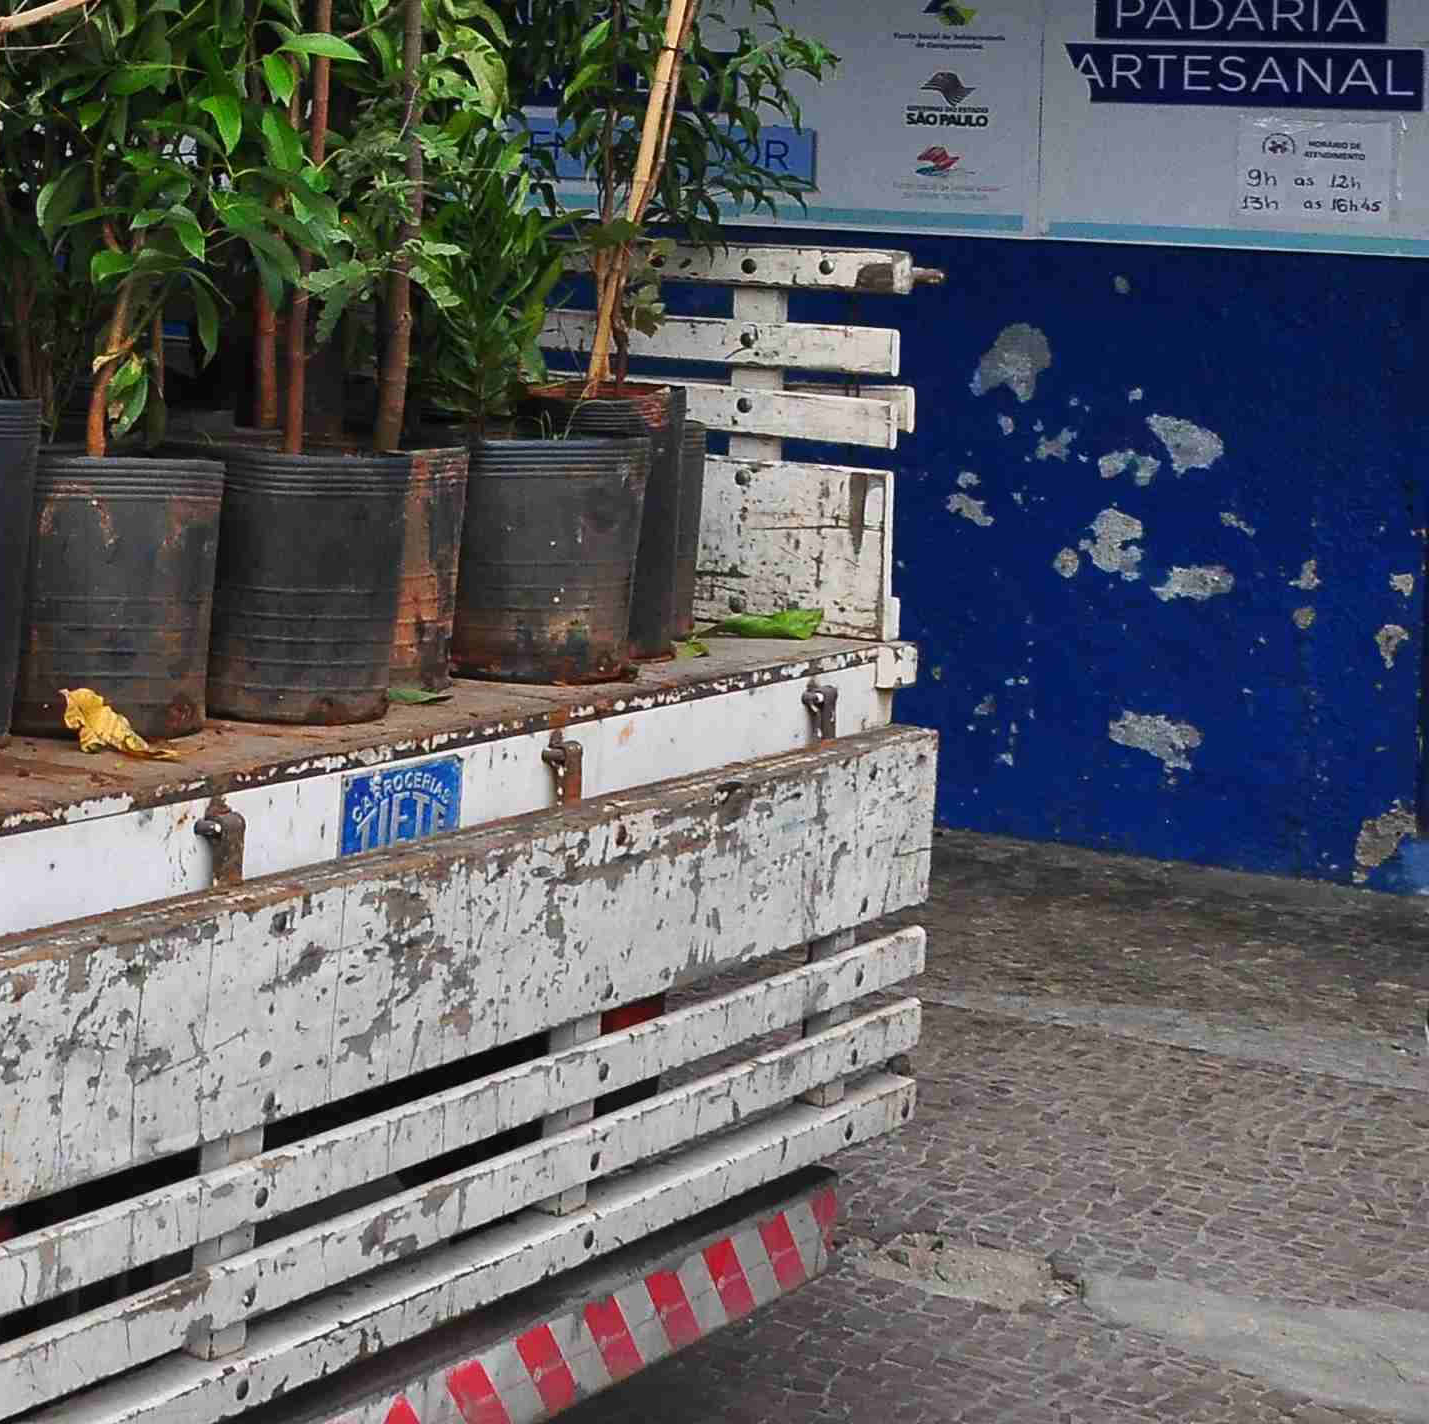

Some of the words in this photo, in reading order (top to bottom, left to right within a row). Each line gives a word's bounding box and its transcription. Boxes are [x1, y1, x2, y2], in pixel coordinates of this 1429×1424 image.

[1076, 53, 1414, 96] ARTESANAL
[940, 114, 989, 127] PAULO
[1247, 168, 1277, 187] 9h
[1329, 174, 1361, 190] 12h
[1241, 195, 1279, 210] 13h
